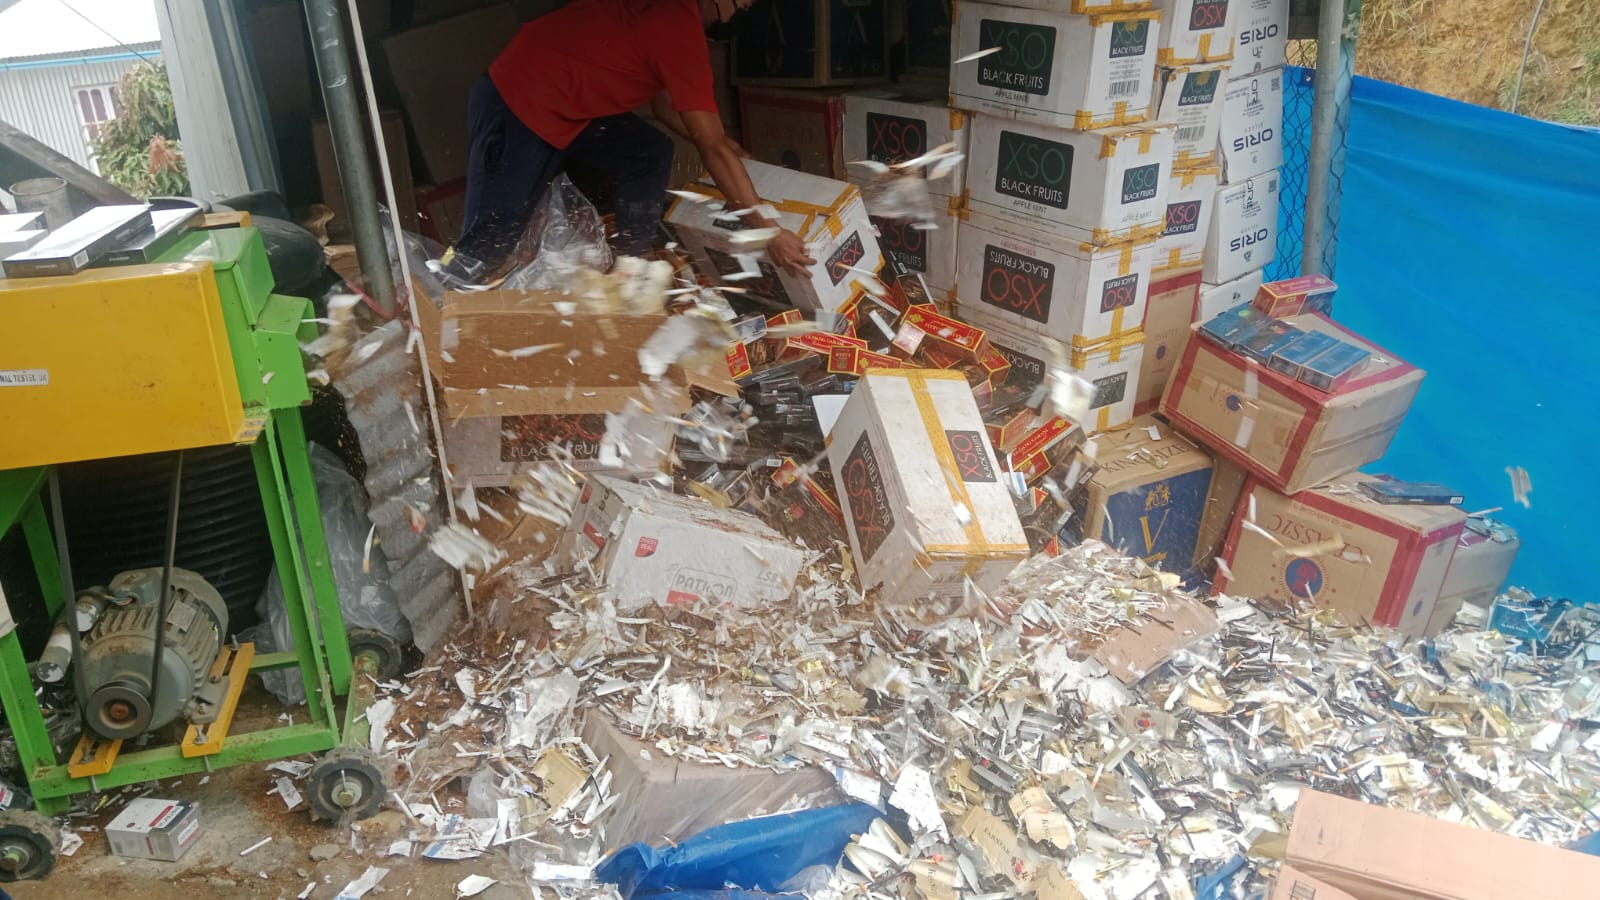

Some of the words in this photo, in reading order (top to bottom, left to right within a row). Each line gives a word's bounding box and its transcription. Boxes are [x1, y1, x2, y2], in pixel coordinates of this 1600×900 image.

[1240, 24, 1278, 45] ORIS
[983, 68, 1013, 85] BLACK
[1014, 73, 1044, 89] FRUITS
[872, 118, 921, 157] XSO
[1233, 128, 1273, 152] ORIS
[1004, 139, 1065, 183] XSO
[1001, 178, 1031, 196] BLACK
[1033, 186, 1063, 203] FRUITS
[1126, 167, 1157, 192] XSO
[1124, 191, 1140, 200] BLACK
[1167, 204, 1198, 225] XSO
[1165, 226, 1180, 234] LACK
[1230, 228, 1268, 252] ORIS
[990, 250, 1017, 269] FRUITS
[1018, 259, 1049, 279] BLACK
[987, 267, 1047, 318] XSO
[1104, 286, 1135, 309] XSO
[1012, 355, 1040, 375] BLACK
[511, 444, 555, 457] BLAC
[951, 433, 985, 478] XSO
[971, 435, 983, 459] FRUITS
[861, 440, 879, 483] FRUITS
[980, 458, 993, 479] BLACK
[848, 458, 882, 549] XSO
[874, 482, 891, 527] BLACK
[1139, 508, 1170, 554] V
